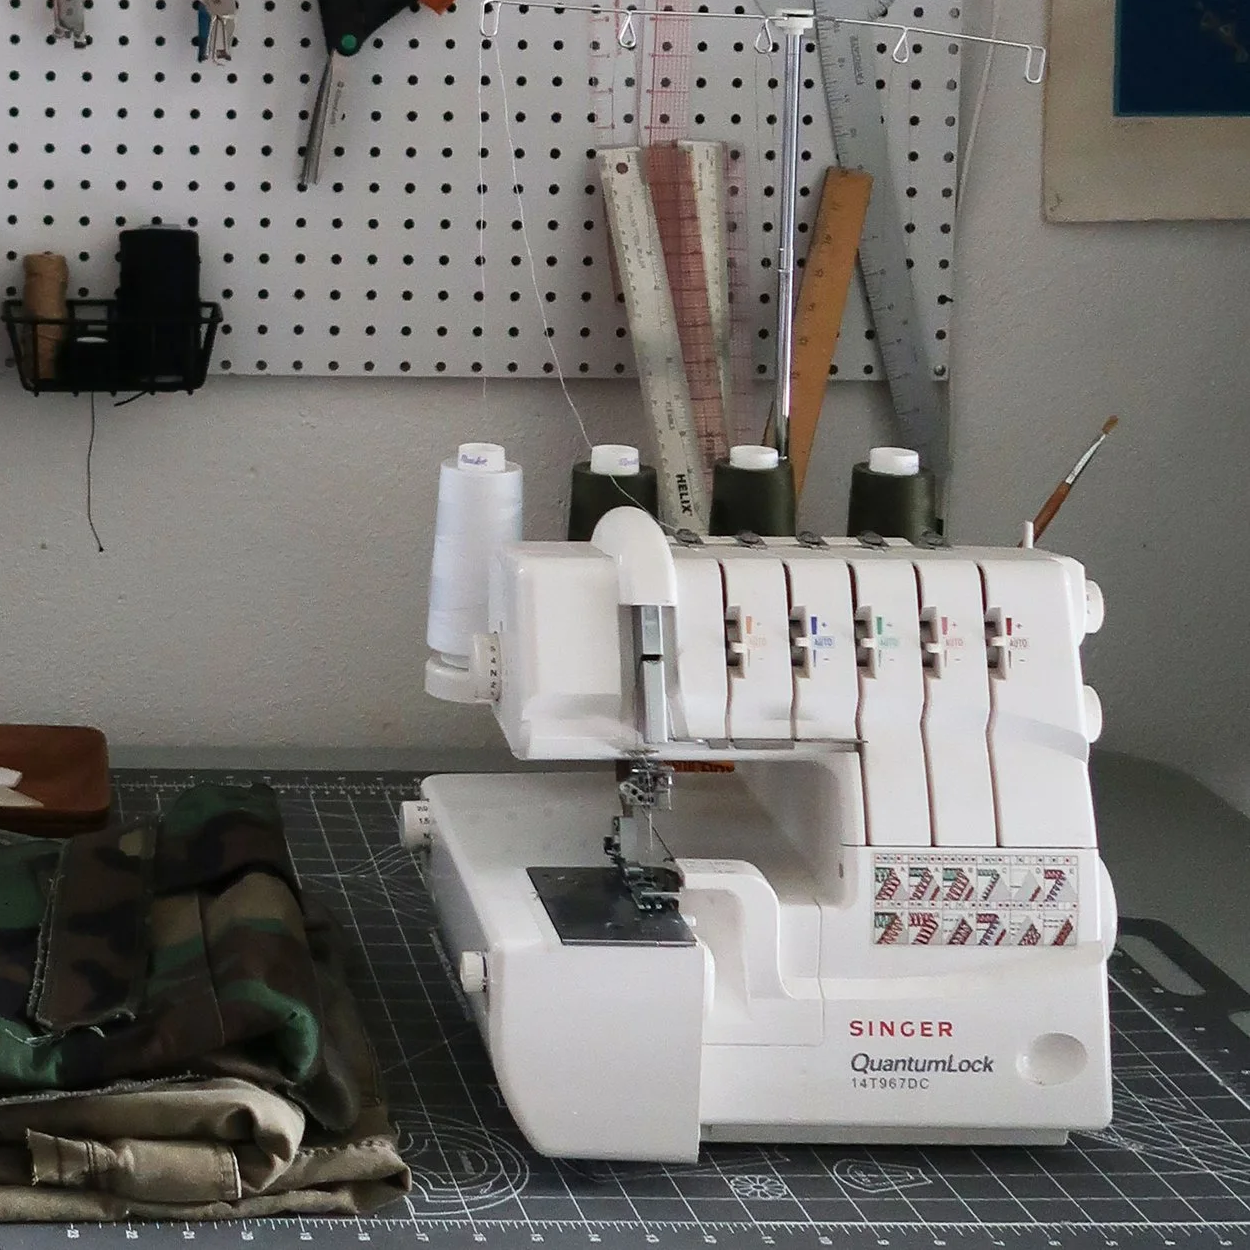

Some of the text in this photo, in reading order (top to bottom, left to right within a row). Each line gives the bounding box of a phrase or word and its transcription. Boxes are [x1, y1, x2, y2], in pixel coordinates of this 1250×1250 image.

[675, 473, 693, 514] HELIX
[814, 637, 833, 647] AUTO
[850, 1020, 953, 1037] SINGER
[851, 1052, 994, 1074] QuantumLock
[852, 1077, 930, 1090] 14T967DC
